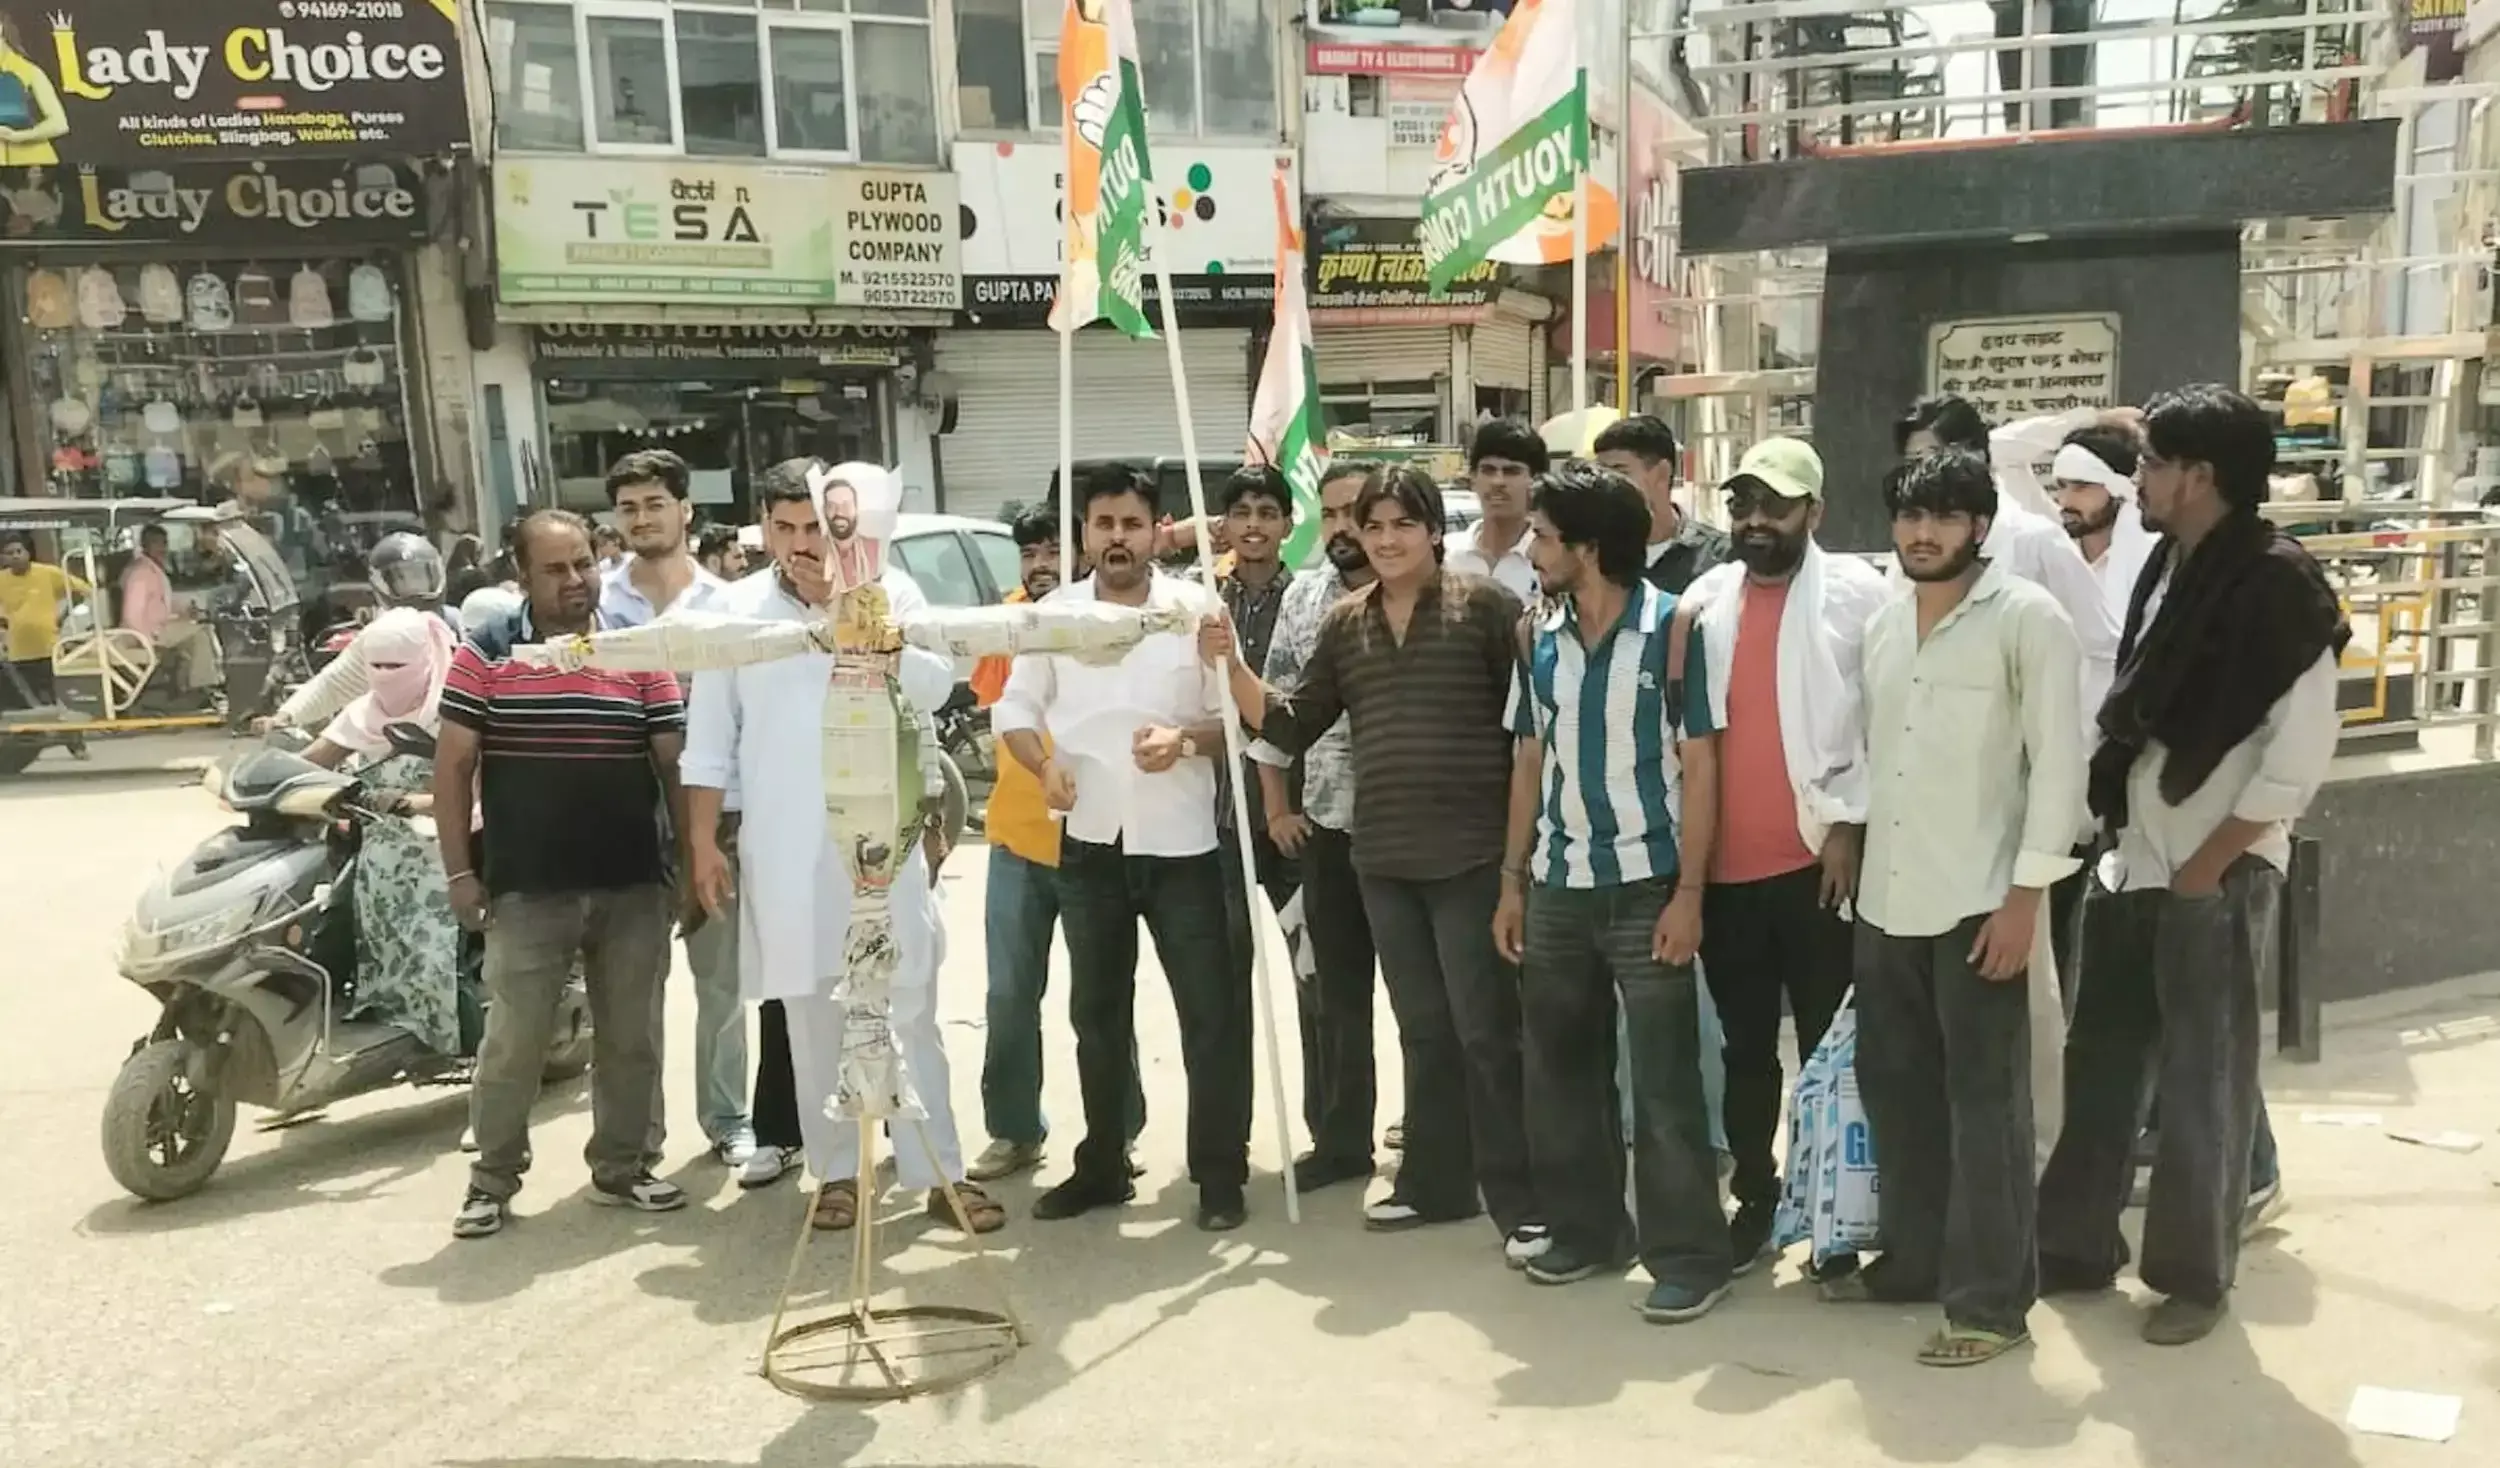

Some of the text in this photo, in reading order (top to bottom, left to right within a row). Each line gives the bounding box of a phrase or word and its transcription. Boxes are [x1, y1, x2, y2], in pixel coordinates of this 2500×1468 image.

[53, 27, 445, 99] Lady Choice
[118, 111, 404, 129] All kinds of Ladies Handbags, Purses
[139, 128, 390, 146] Clutches, Slingbag, Wallets etc.
[79, 173, 415, 232] Lady Choice
[861, 181, 927, 203] GUPTA
[573, 202, 760, 242] TESA
[847, 211, 942, 232] PLYWOOD
[848, 240, 943, 262] COMPANY
[975, 281, 1031, 303] GUPTA
